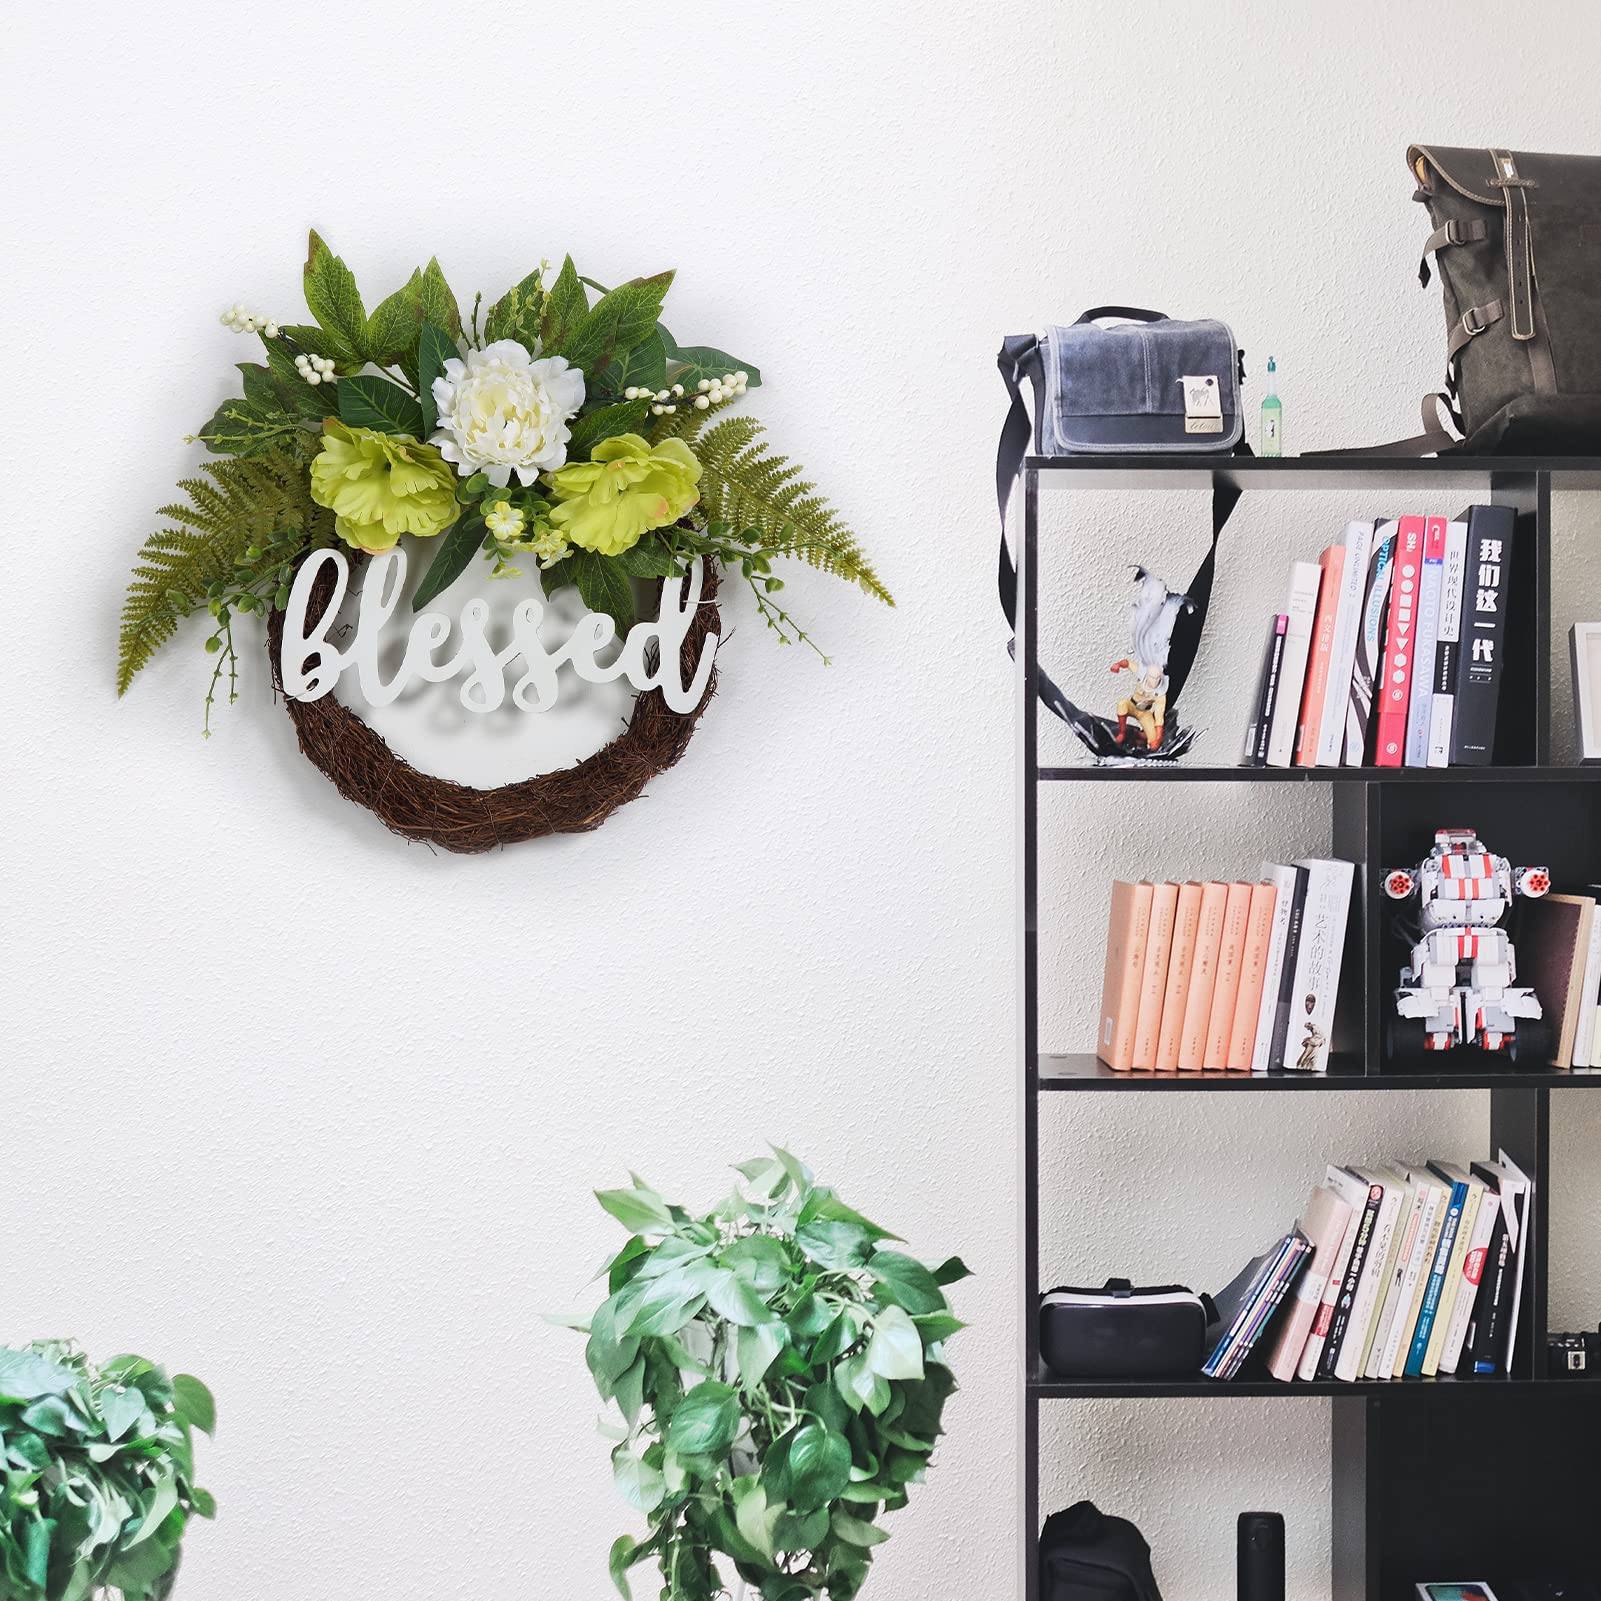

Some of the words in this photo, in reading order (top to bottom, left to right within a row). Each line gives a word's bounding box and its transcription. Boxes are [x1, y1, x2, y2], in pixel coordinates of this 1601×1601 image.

[1374, 535, 1392, 582] OPTICAL
[1423, 570, 1438, 617] NAOTO
[1443, 550, 1460, 637] 世界现代设计史
[281, 546, 718, 714] blessed
[1366, 582, 1384, 642] ILLUSIONS
[1471, 538, 1503, 663] 我们这一代
[1417, 620, 1434, 699] FUKASAWA
[1309, 912, 1330, 992] 艺术的故事
